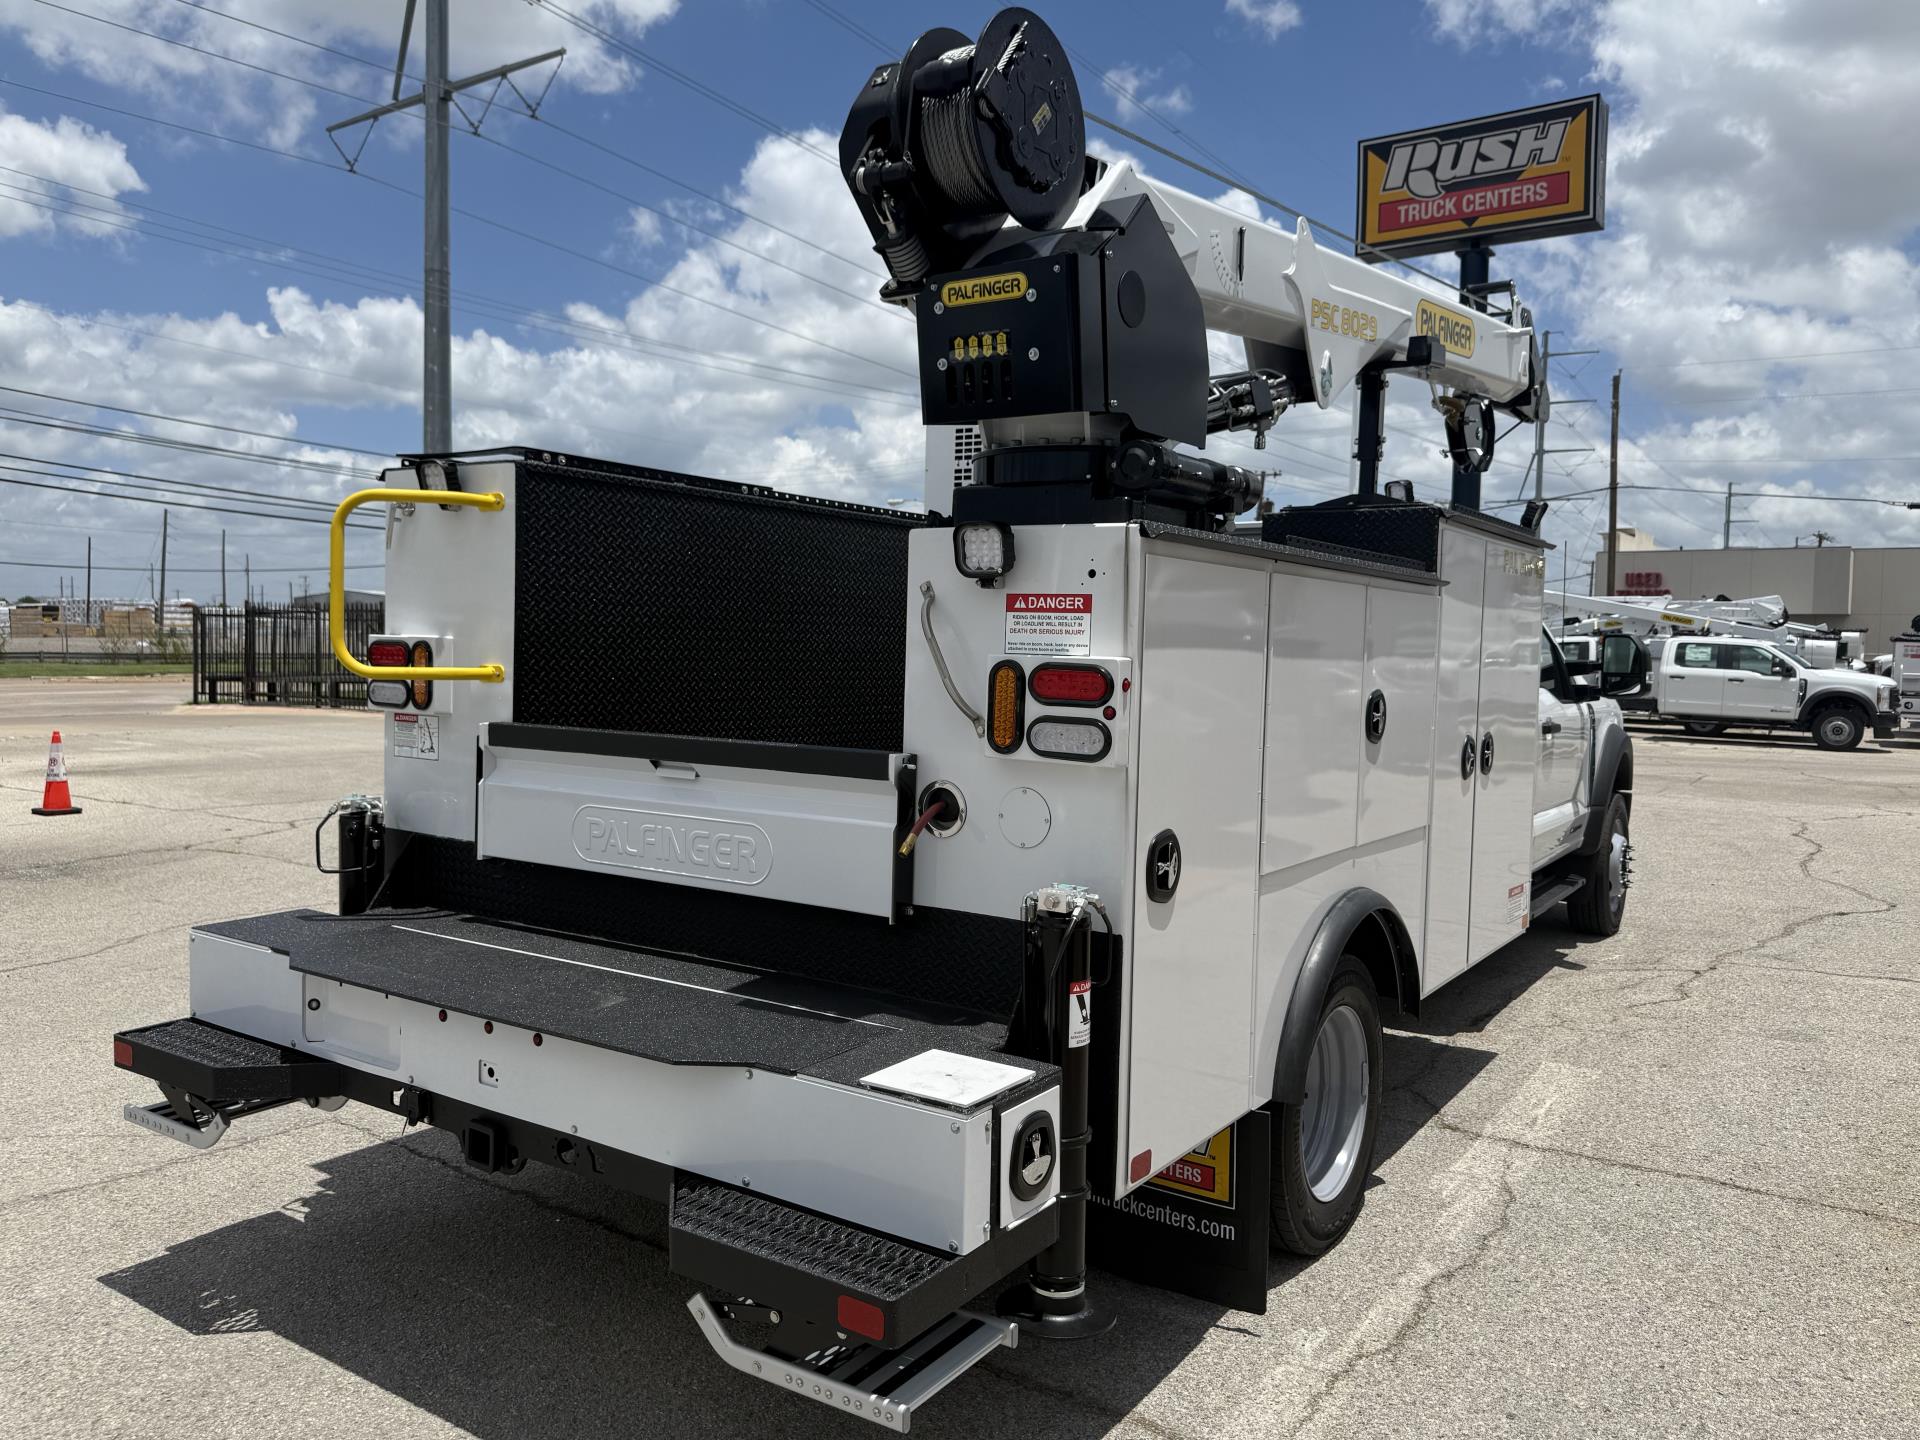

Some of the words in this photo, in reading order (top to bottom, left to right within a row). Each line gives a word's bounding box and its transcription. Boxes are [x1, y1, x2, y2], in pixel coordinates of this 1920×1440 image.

[1380, 118, 1571, 199] RUSH
[1397, 199, 1458, 224] TRUCK
[1462, 182, 1549, 215] CENTERS
[947, 277, 1021, 303] PALFINGER
[1310, 298, 1340, 333] PSC
[1340, 307, 1377, 342] 8029
[1420, 308, 1472, 351] PALFINGER
[1625, 572, 1663, 588] USED
[1028, 596, 1084, 609] DANGER
[584, 816, 757, 874] PALFINGER
